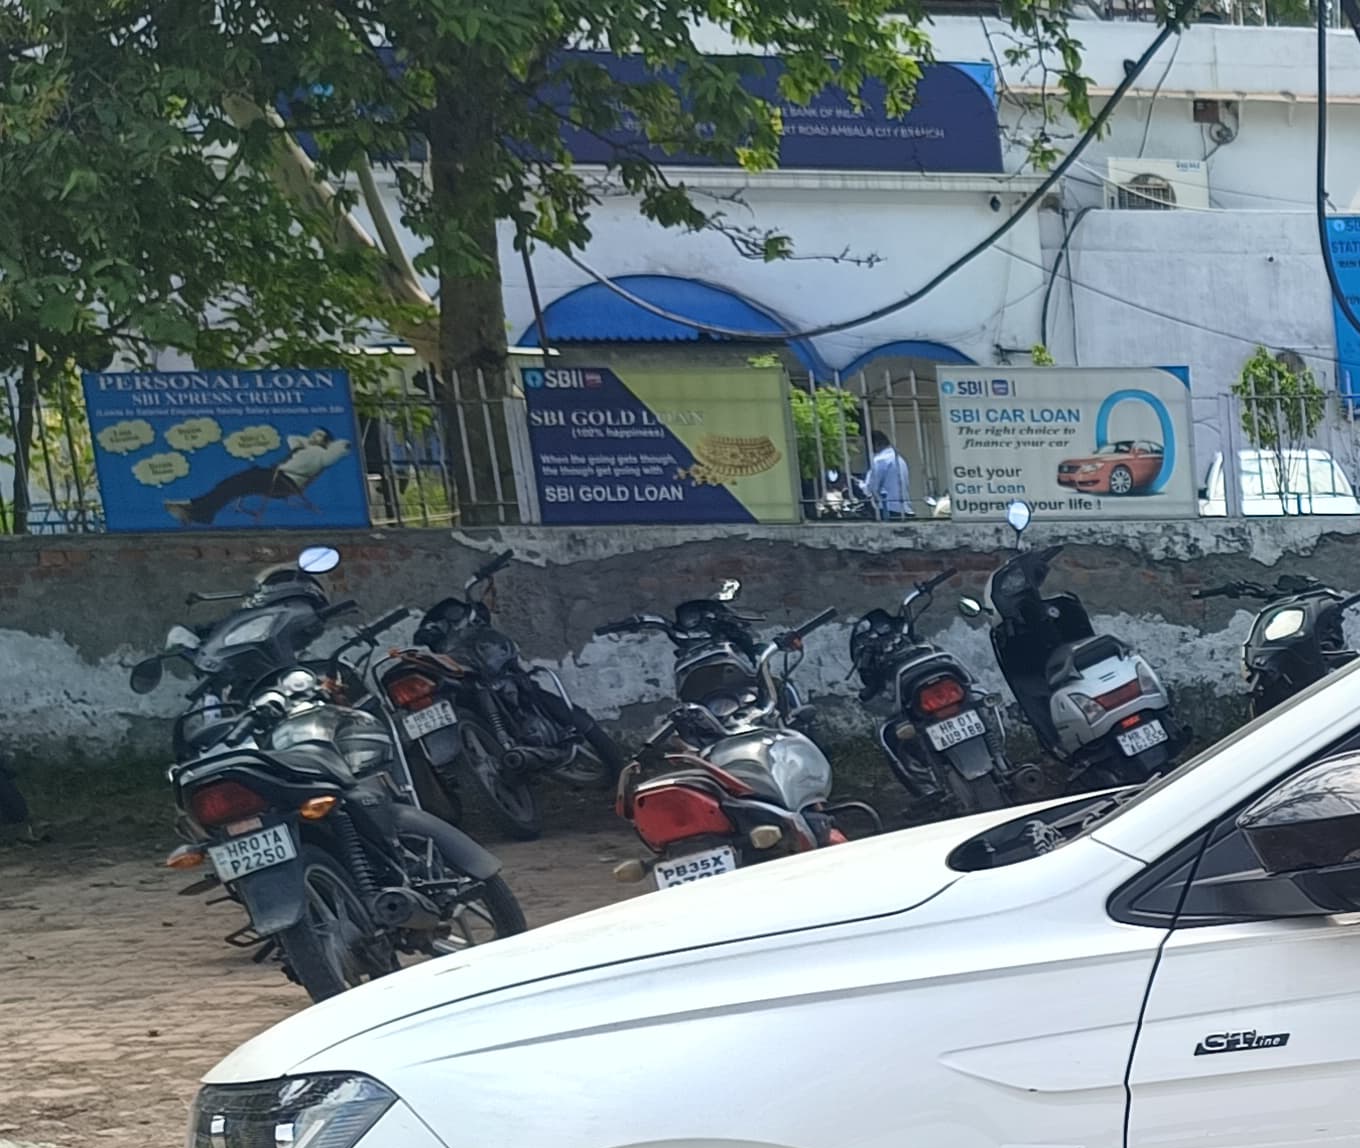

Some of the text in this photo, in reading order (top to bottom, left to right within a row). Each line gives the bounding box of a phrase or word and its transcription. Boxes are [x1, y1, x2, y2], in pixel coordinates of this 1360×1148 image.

[100, 373, 334, 391] PERSONAL LOAN
[545, 370, 577, 389] SBI
[957, 381, 982, 396] SBI
[132, 390, 304, 406] SBI XPRESS CREDIT
[530, 411, 567, 427] SBI
[571, 409, 636, 426] GOLD
[950, 408, 1080, 423] SBI CAR LOAN
[957, 425, 1076, 438] The right choice to
[962, 438, 1070, 450] finance your car
[954, 466, 1022, 480] Get your
[545, 485, 684, 501] SBI GOLD LOAN
[955, 482, 1026, 495] Car Loan
[1068, 498, 1093, 511] life
[662, 855, 725, 881] PB35X
[1202, 1029, 1282, 1051] GT Line
